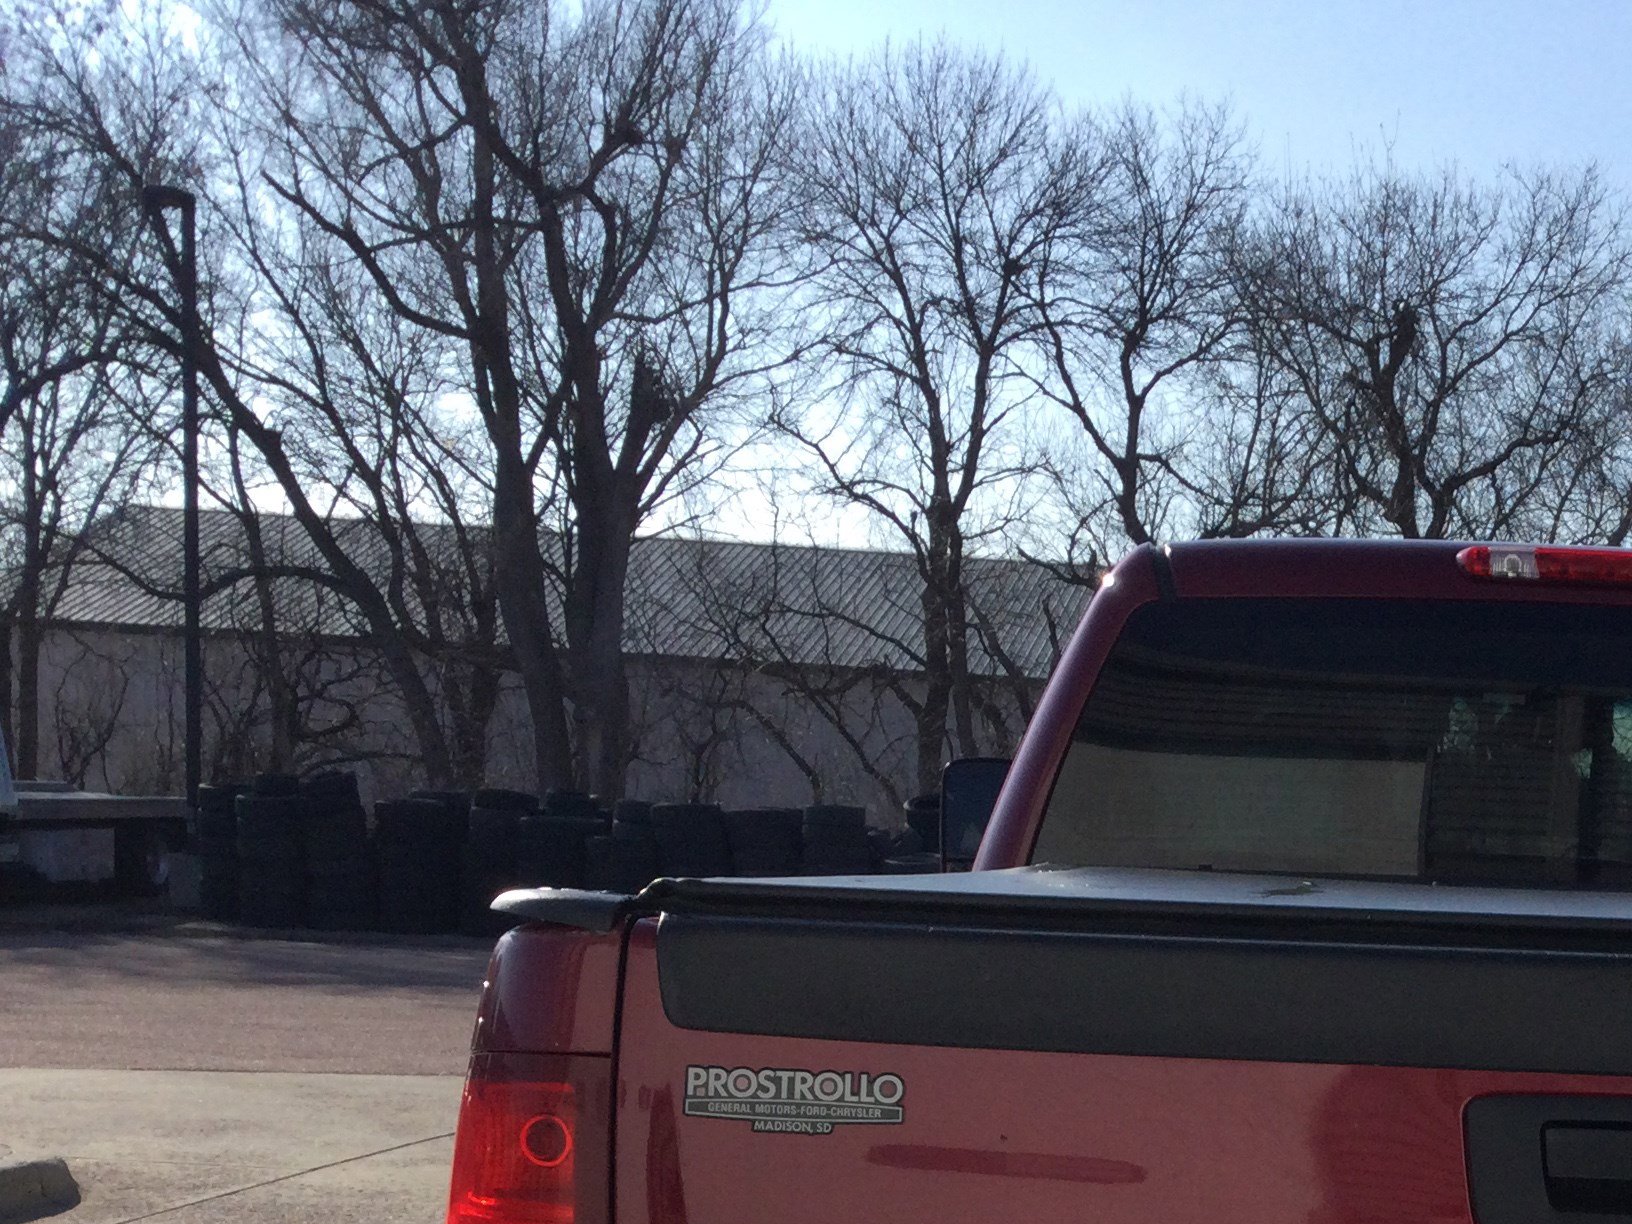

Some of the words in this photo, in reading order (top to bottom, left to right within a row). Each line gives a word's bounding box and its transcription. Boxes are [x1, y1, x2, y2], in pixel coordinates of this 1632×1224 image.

[686, 1066, 904, 1104] PROSTROLLO
[707, 1101, 752, 1114] GENERAL
[753, 1119, 814, 1134] MADISON,
[816, 1122, 832, 1134] SD
